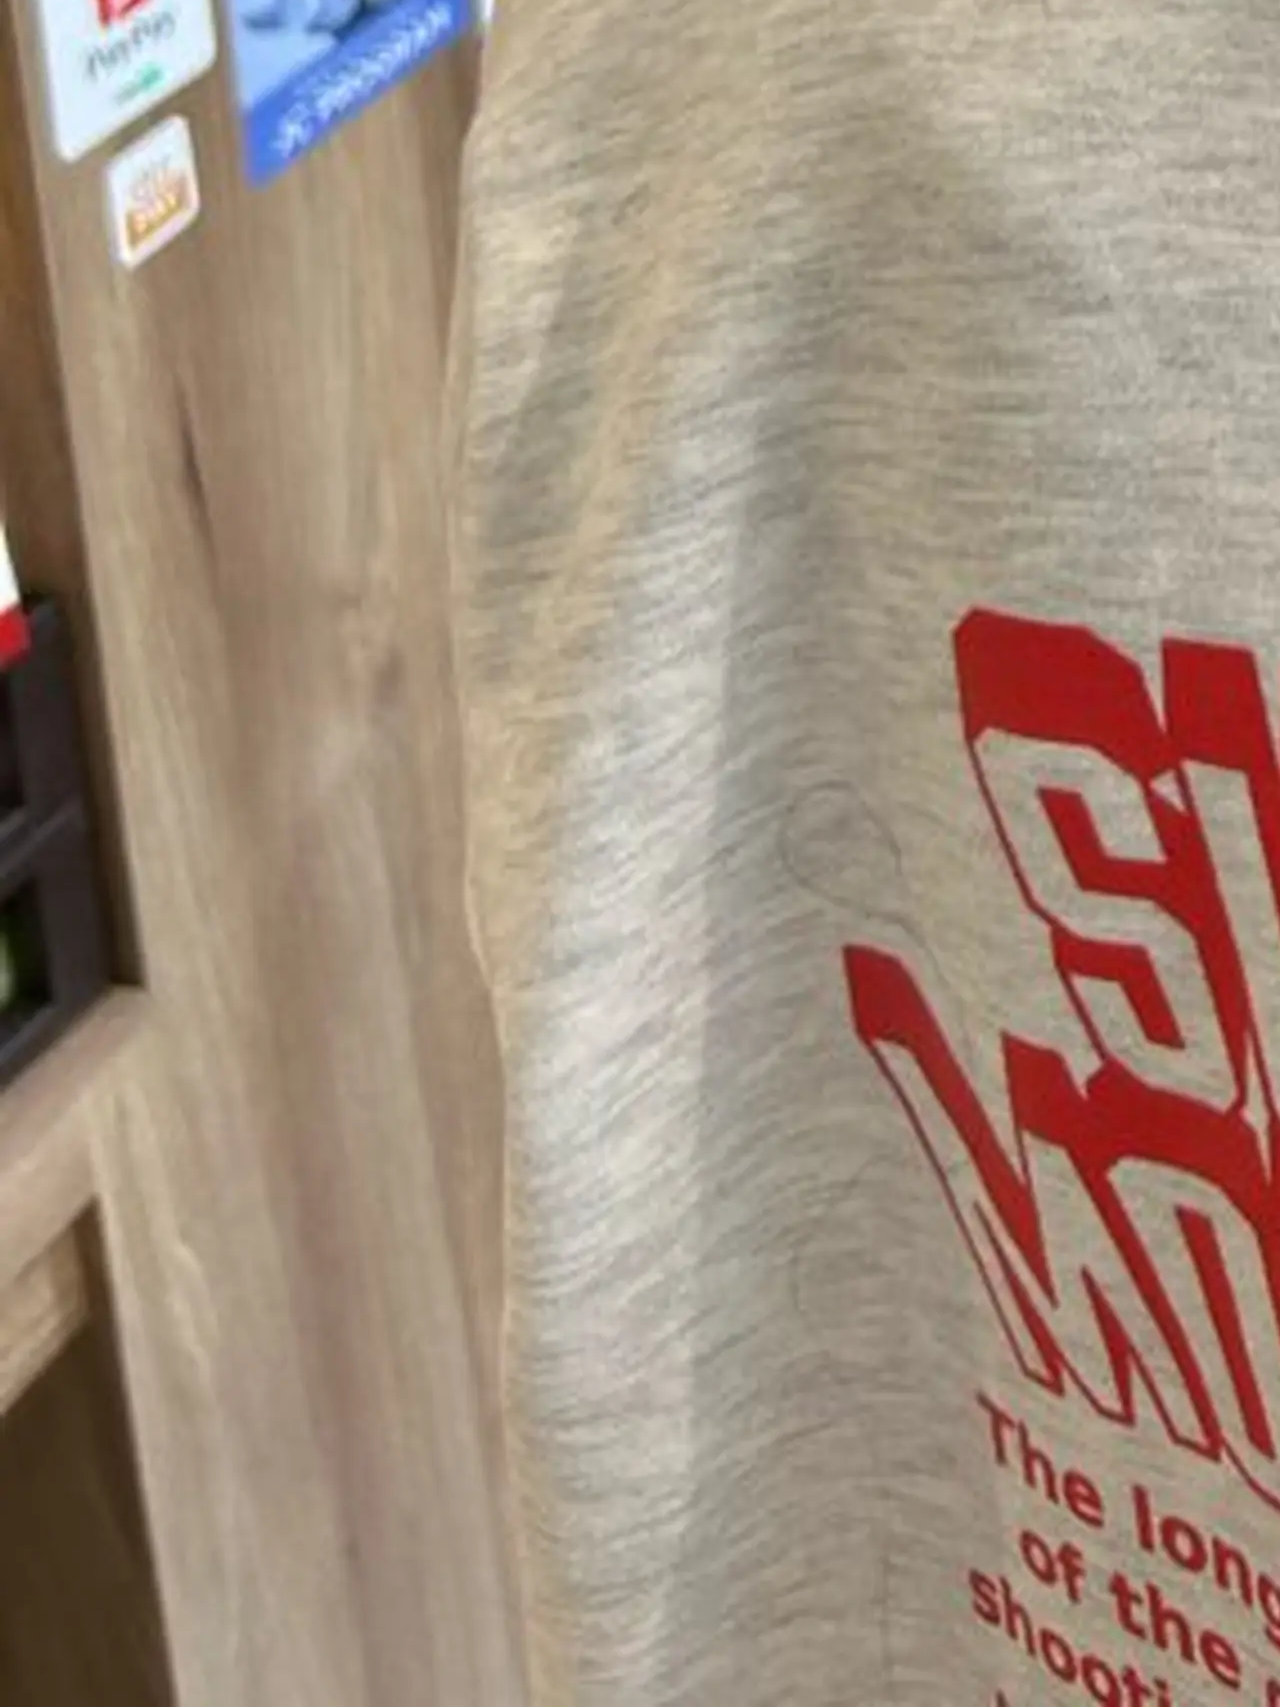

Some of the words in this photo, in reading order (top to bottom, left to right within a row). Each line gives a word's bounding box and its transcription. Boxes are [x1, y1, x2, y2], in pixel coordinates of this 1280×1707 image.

[977, 1390, 1104, 1528] The
[1018, 1529, 1085, 1604] of
[1108, 1570, 1241, 1690] the
